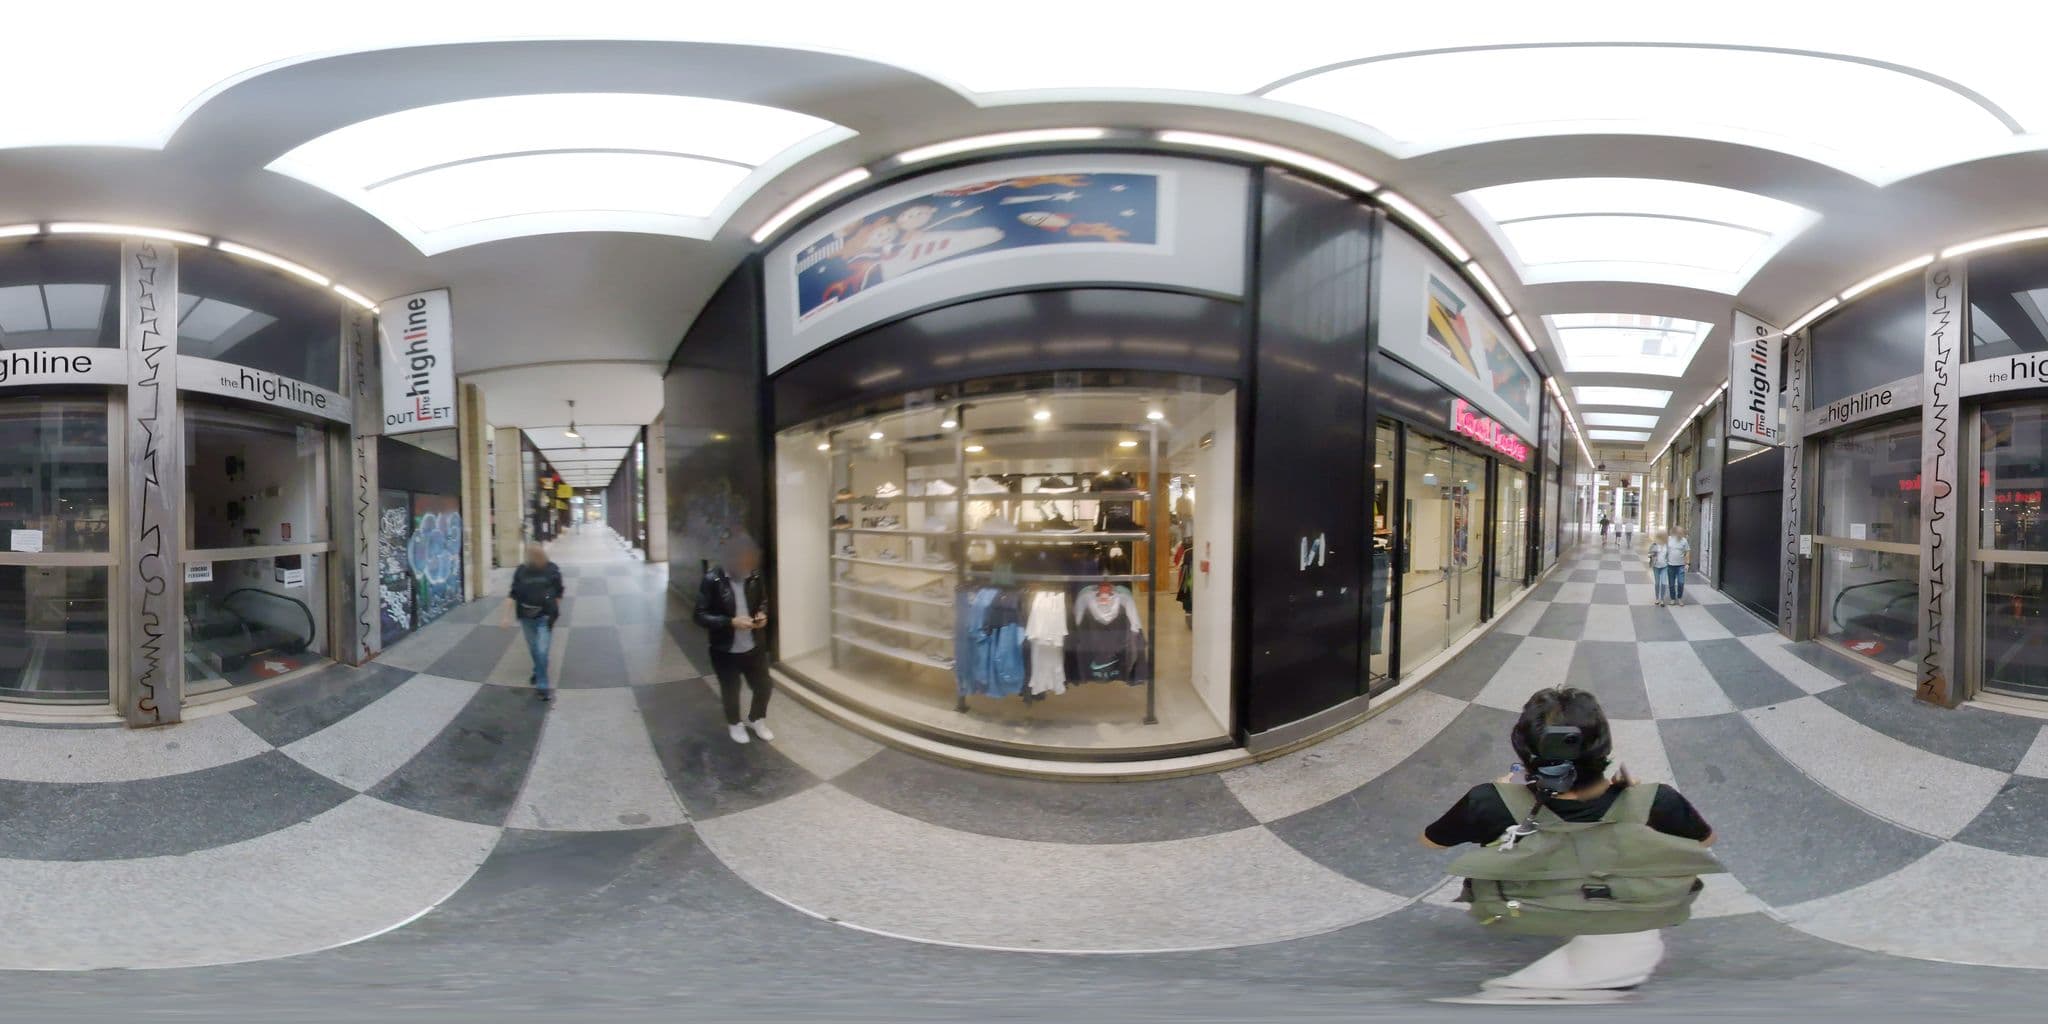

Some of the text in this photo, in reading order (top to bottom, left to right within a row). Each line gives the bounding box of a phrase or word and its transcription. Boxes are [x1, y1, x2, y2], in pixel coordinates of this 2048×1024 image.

[404, 297, 436, 398] highline
[220, 368, 326, 409] the highline
[1749, 325, 1771, 414] highline
[1989, 373, 2008, 383] the
[1828, 390, 1892, 423] highline
